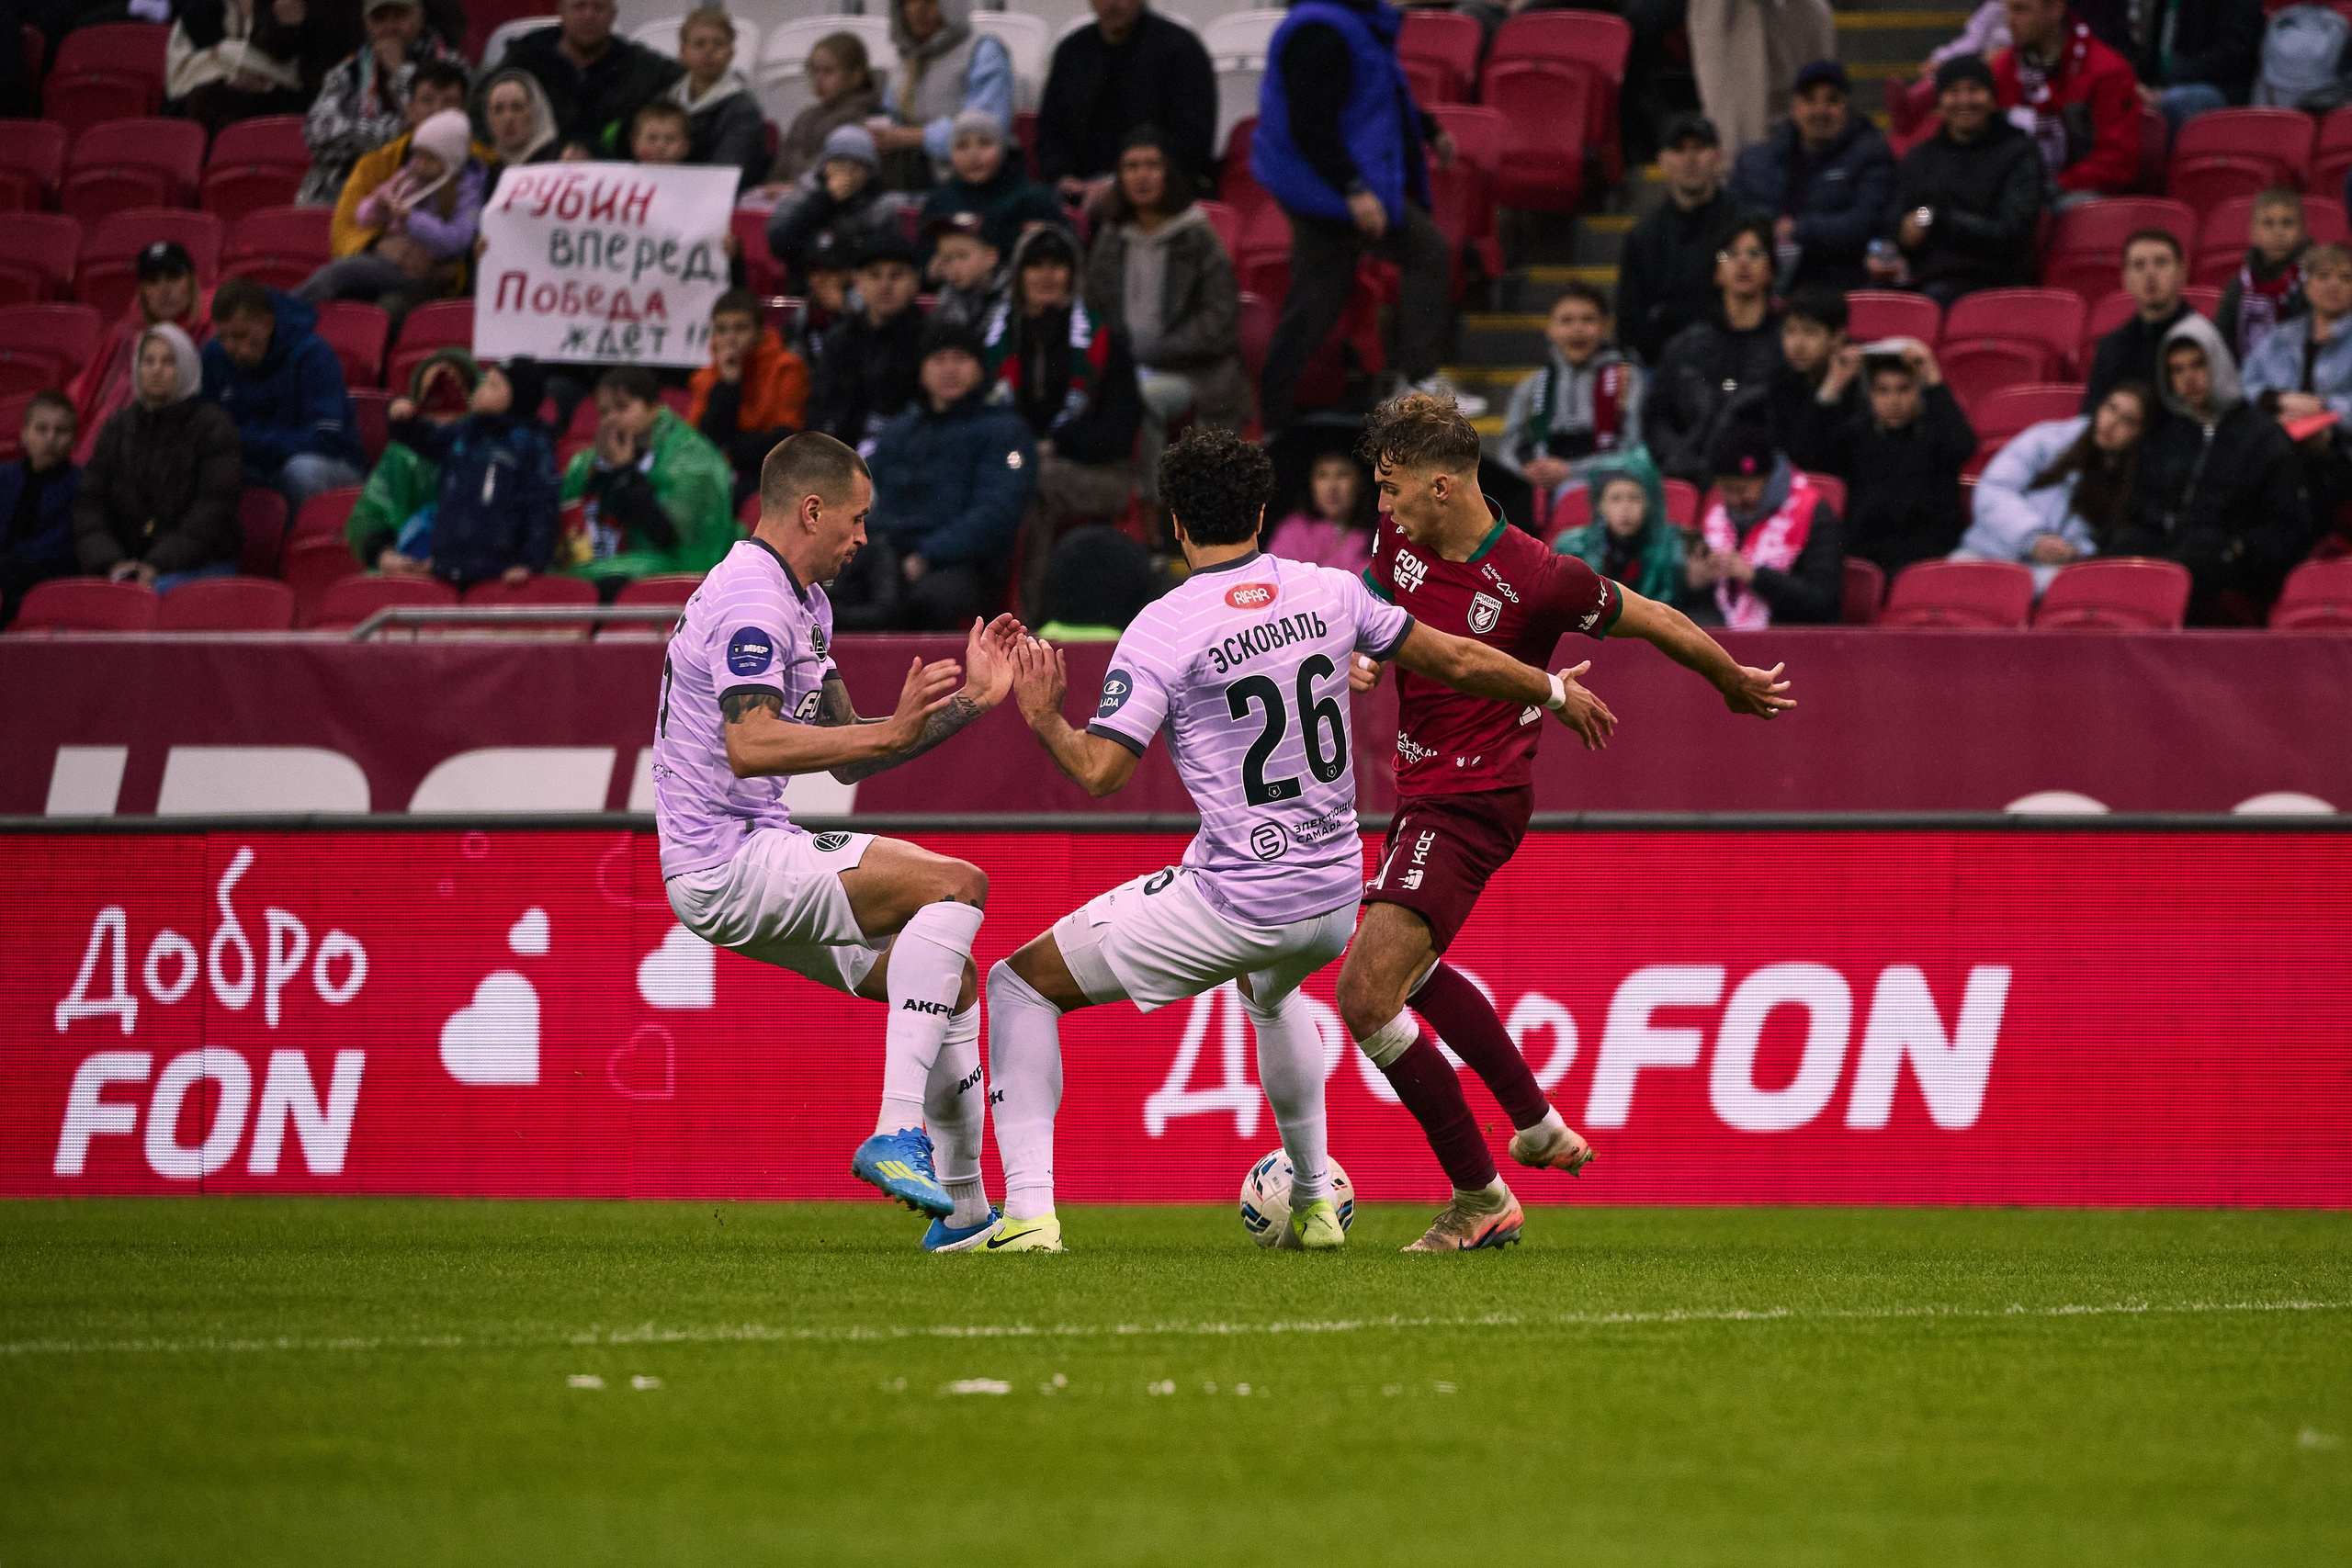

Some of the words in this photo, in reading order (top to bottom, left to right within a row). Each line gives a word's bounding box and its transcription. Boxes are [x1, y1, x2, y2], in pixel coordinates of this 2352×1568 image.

[503, 174, 658, 227] РУБИН
[1394, 564, 1424, 593] BET
[1396, 548, 1429, 580] FON
[1233, 587, 1270, 605] RIFAR
[1208, 612, 1327, 673] ЭСКОВАЛЬ
[1100, 697, 1119, 708] LADA
[1225, 653, 1348, 807] 26
[1296, 820, 1341, 843] САМАРА
[57, 850, 365, 1031] Добро
[1585, 963, 2010, 1132] FON
[56, 1049, 363, 1176] FON
